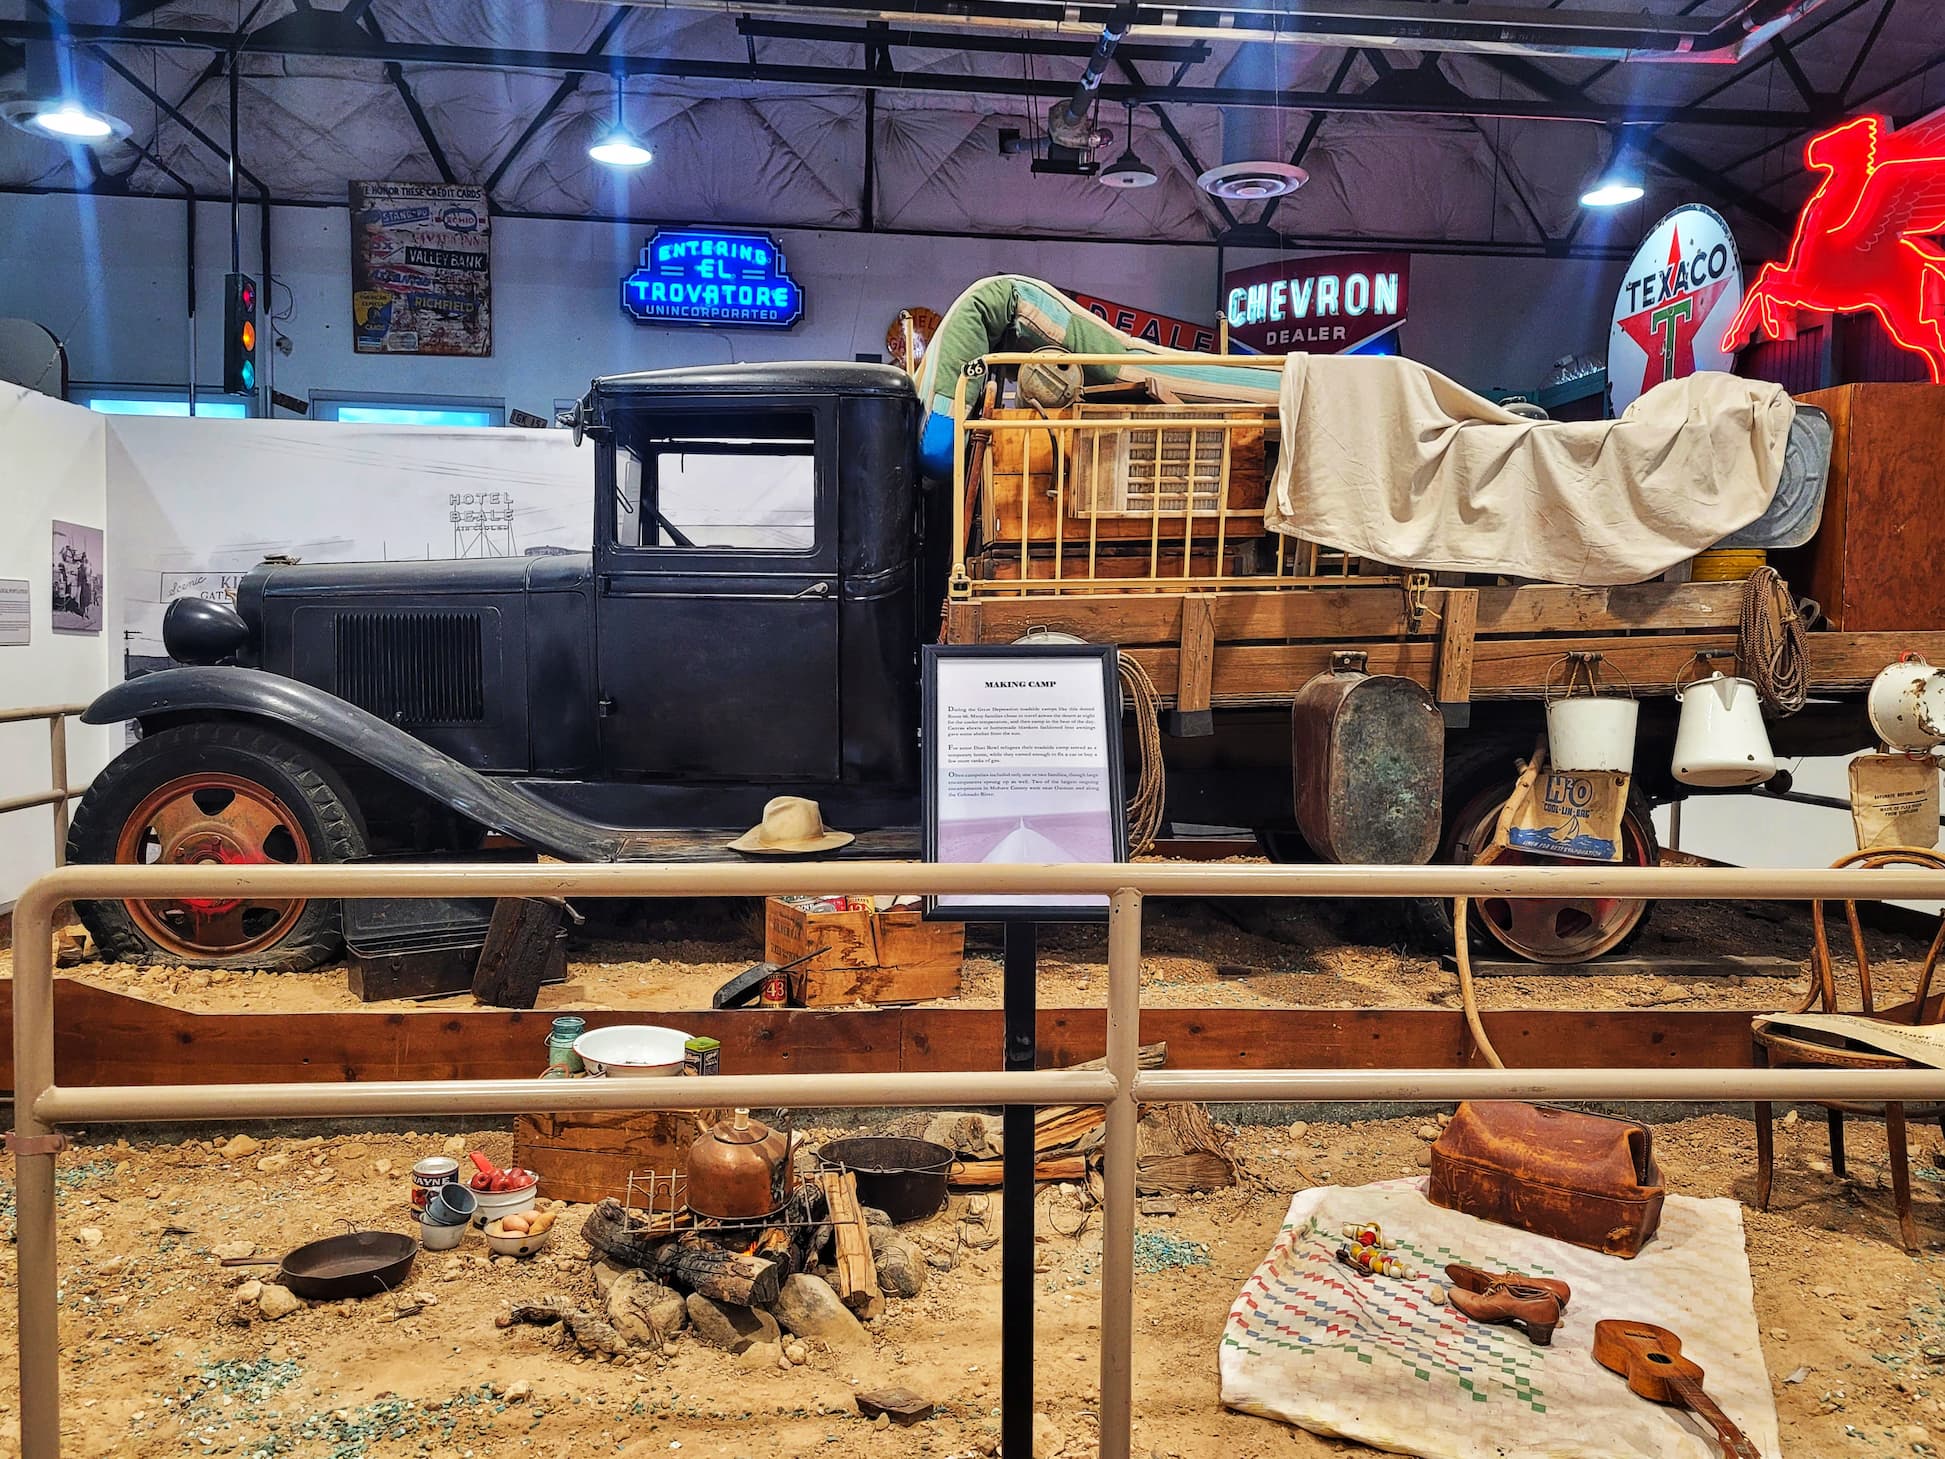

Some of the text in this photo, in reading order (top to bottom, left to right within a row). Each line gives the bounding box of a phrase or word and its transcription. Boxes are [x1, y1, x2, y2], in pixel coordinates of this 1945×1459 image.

[372, 185, 400, 196] HONOR
[402, 188, 424, 197] THESE
[427, 189, 455, 198] CREDIT
[457, 189, 481, 199] CARDS
[409, 248, 483, 269] VALLEY BANK
[658, 240, 768, 266] ENTERING
[697, 258, 733, 279] EL
[1625, 243, 1728, 314] TEXACO
[631, 280, 789, 307] TROVATORE
[1228, 272, 1399, 328] CHEVRON
[415, 297, 475, 313] RICHFIELD
[645, 304, 778, 320] UNINCORPORATED
[1089, 301, 1214, 351] DEALE
[1266, 326, 1346, 346] DEALER
[967, 364, 983, 376] 66
[449, 492, 514, 506] HOTEL
[449, 509, 514, 522] BEALE
[168, 576, 207, 597] Scenic
[766, 981, 785, 997] 43
